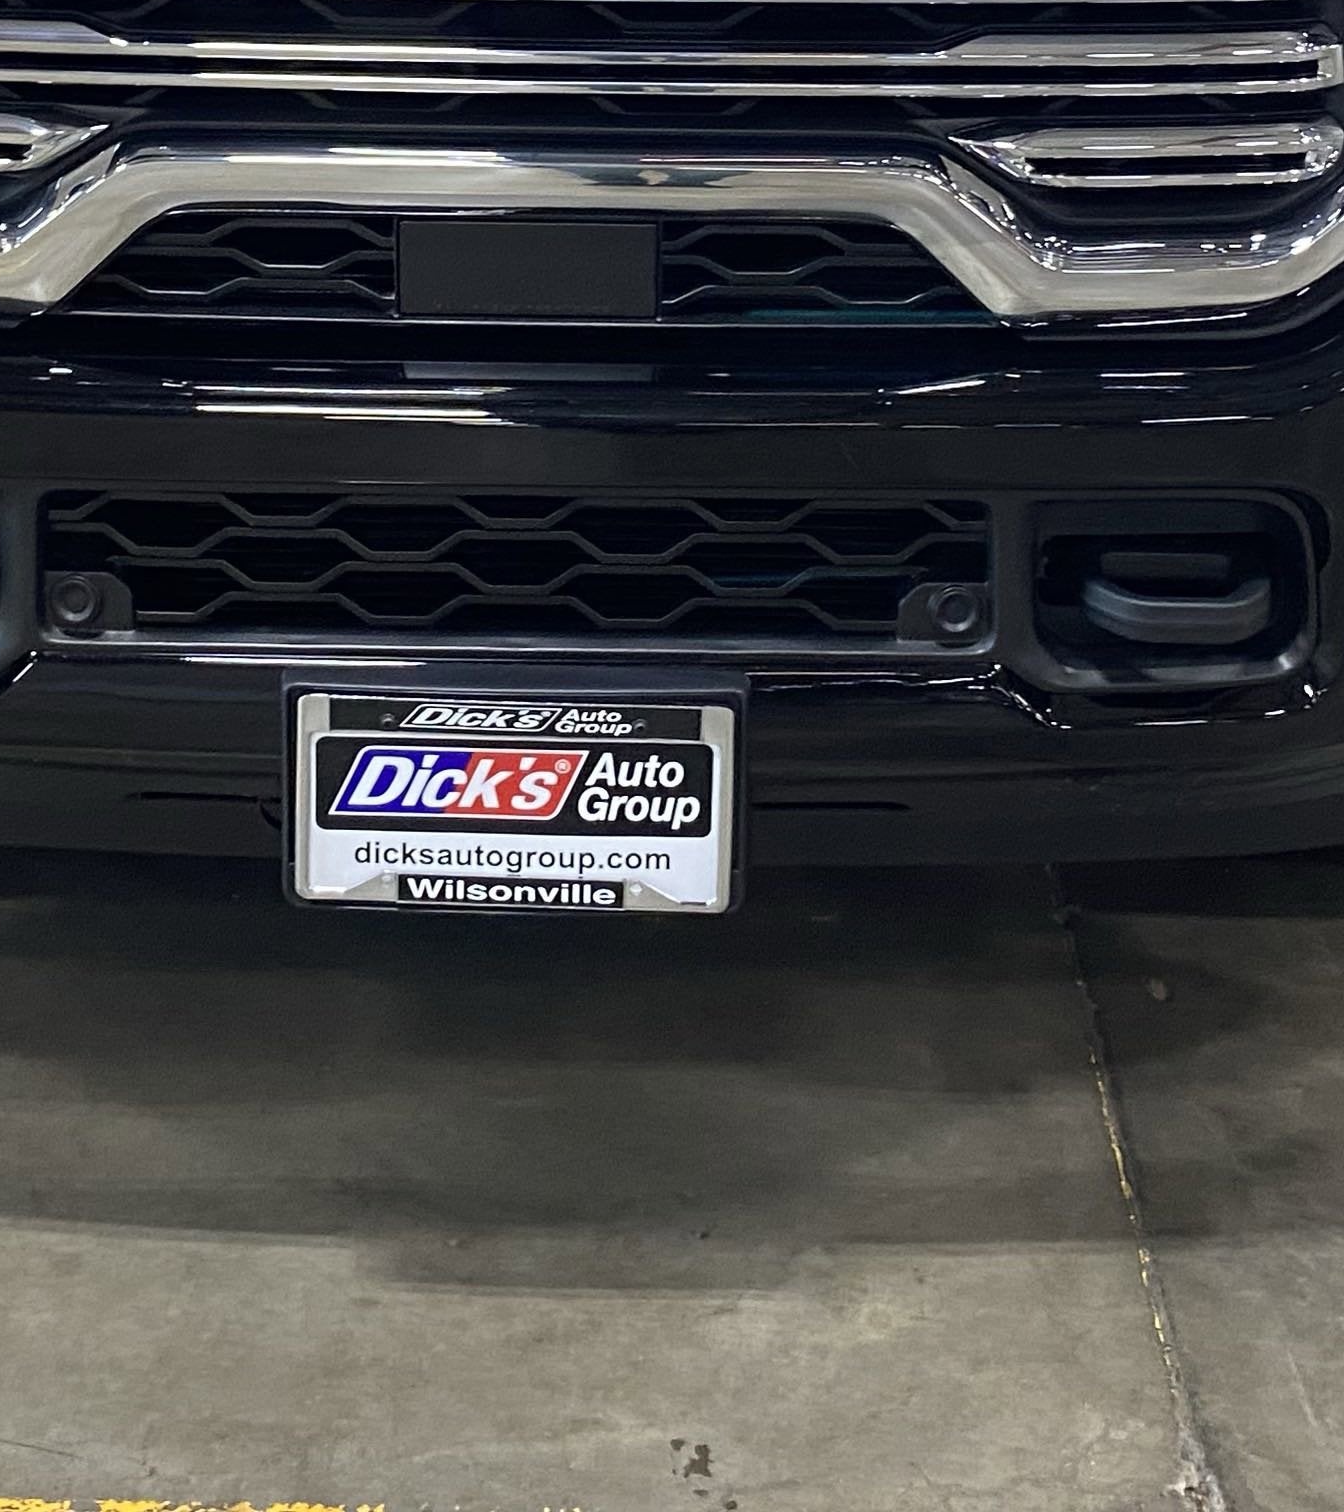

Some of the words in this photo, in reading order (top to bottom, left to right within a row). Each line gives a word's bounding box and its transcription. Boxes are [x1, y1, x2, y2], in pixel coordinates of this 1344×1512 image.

[412, 706, 544, 730] Dick's
[555, 721, 633, 737] Group
[560, 709, 623, 723] Auto
[347, 754, 560, 811] Dick's
[585, 752, 685, 788] Auto
[577, 787, 702, 830] Group
[354, 841, 672, 873] dicksautogroup.com
[406, 878, 617, 905] Wilsonville
